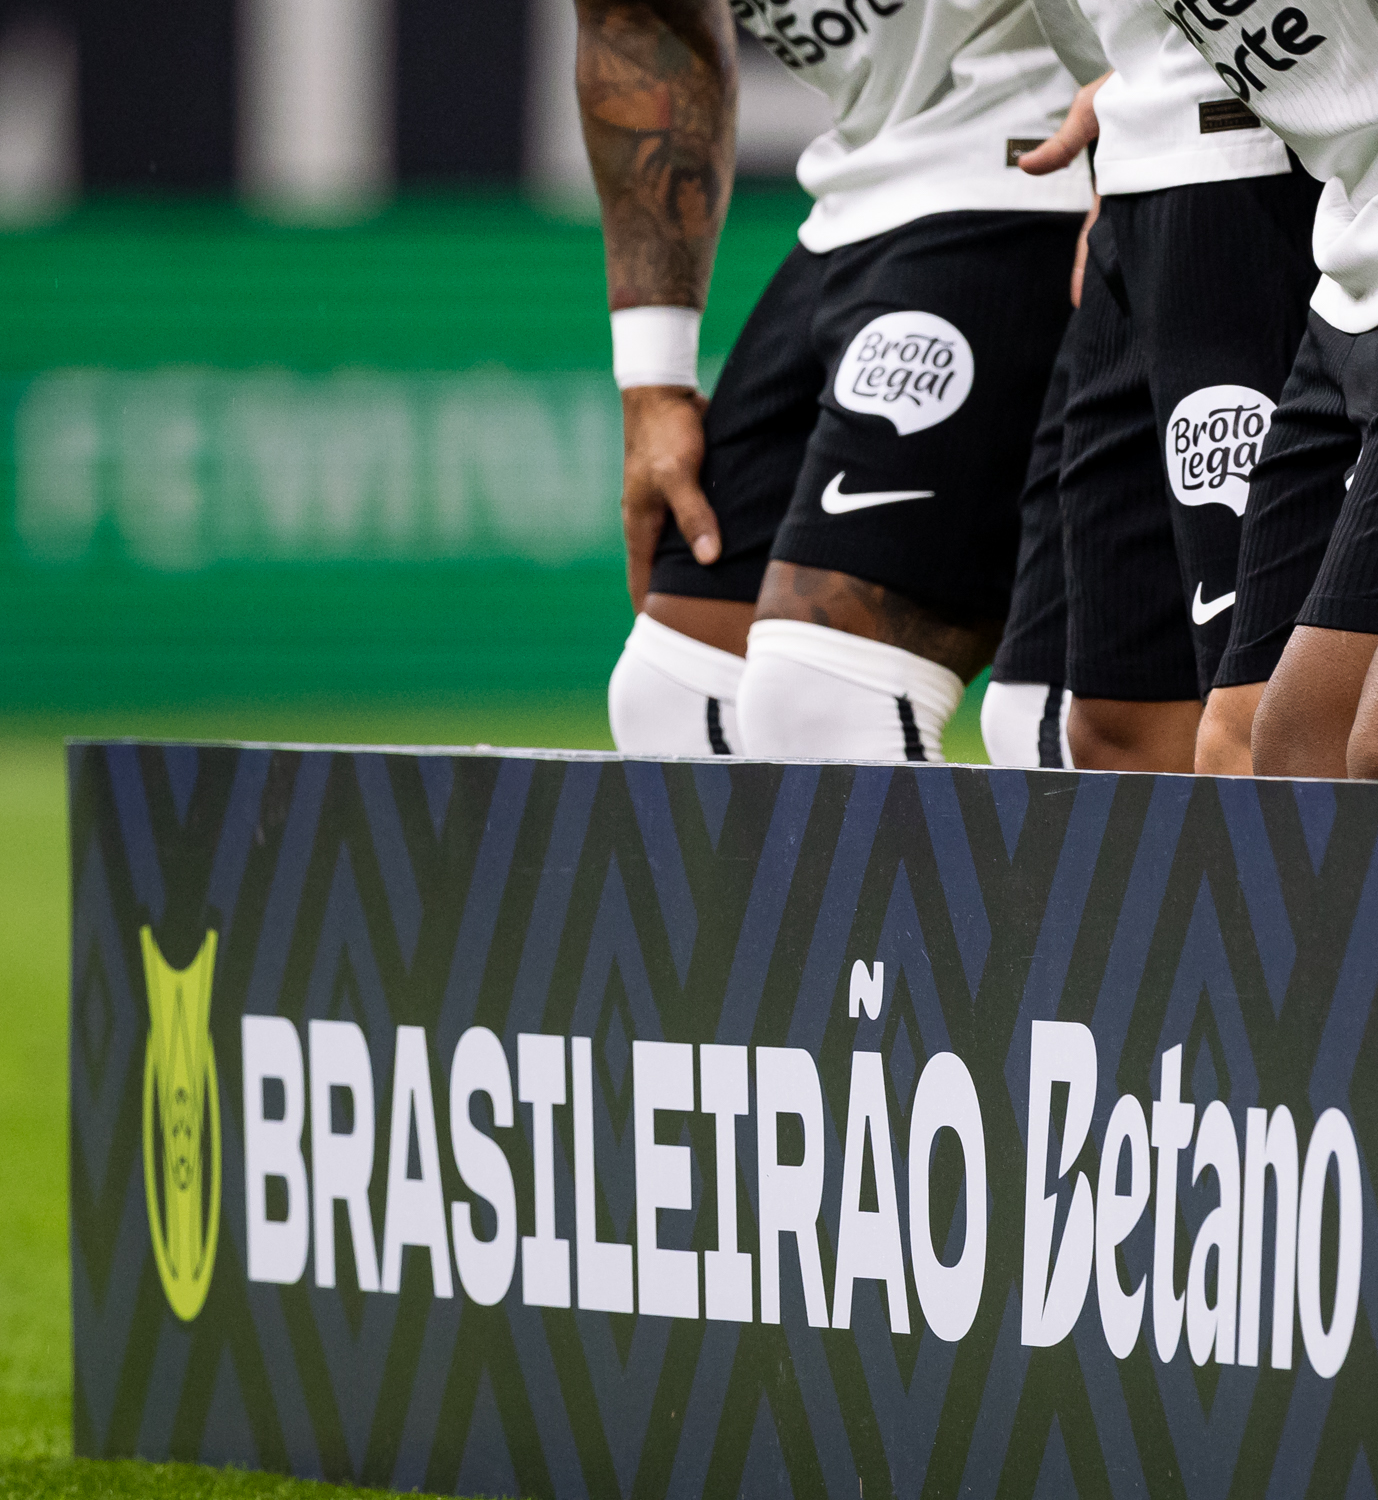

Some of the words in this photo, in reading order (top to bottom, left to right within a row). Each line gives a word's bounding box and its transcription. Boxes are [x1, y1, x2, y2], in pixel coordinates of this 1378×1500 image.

[857, 332, 955, 368] Broto
[852, 367, 955, 406] Legal
[1171, 404, 1264, 456] Broto
[1182, 442, 1258, 490] Lega
[241, 958, 988, 1342] BRASILEIRÃO
[1021, 1020, 1363, 1378] Betano
